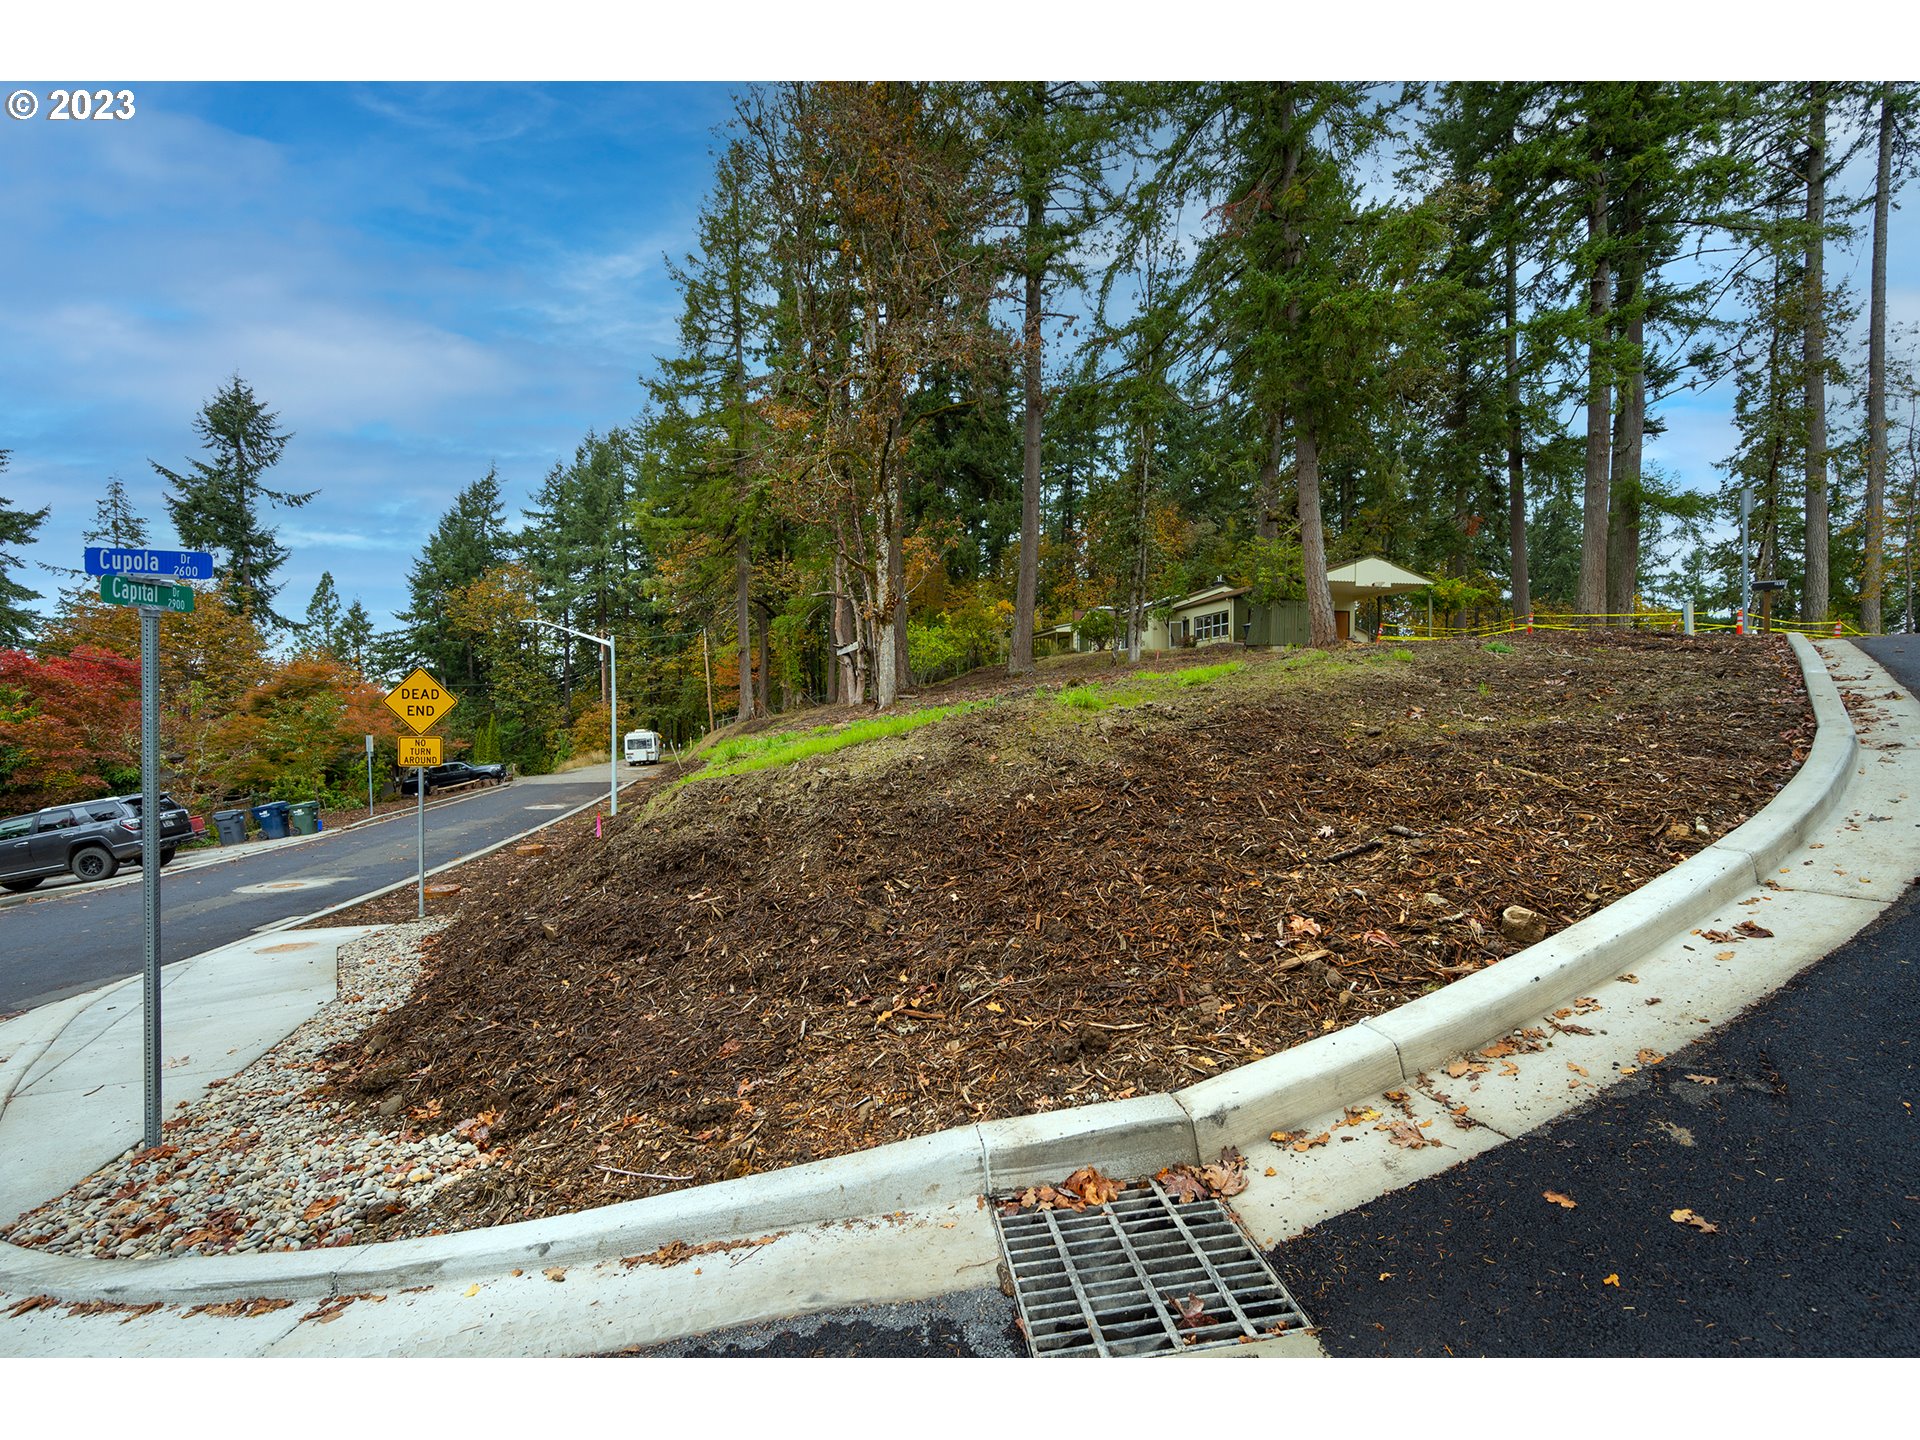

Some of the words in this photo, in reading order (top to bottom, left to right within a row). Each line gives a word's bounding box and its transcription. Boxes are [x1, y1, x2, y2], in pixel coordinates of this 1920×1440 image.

[99, 549, 159, 573] Cupola
[180, 553, 191, 565] Dr
[173, 565, 199, 577] 2600
[112, 577, 158, 603] Capital
[172, 587, 180, 598] Dr
[167, 598, 186, 610] 2900
[401, 688, 440, 700] DEAD
[407, 705, 435, 717] END
[414, 739, 426, 747] NO
[410, 747, 432, 756] TURN
[403, 756, 438, 764] AROUND
